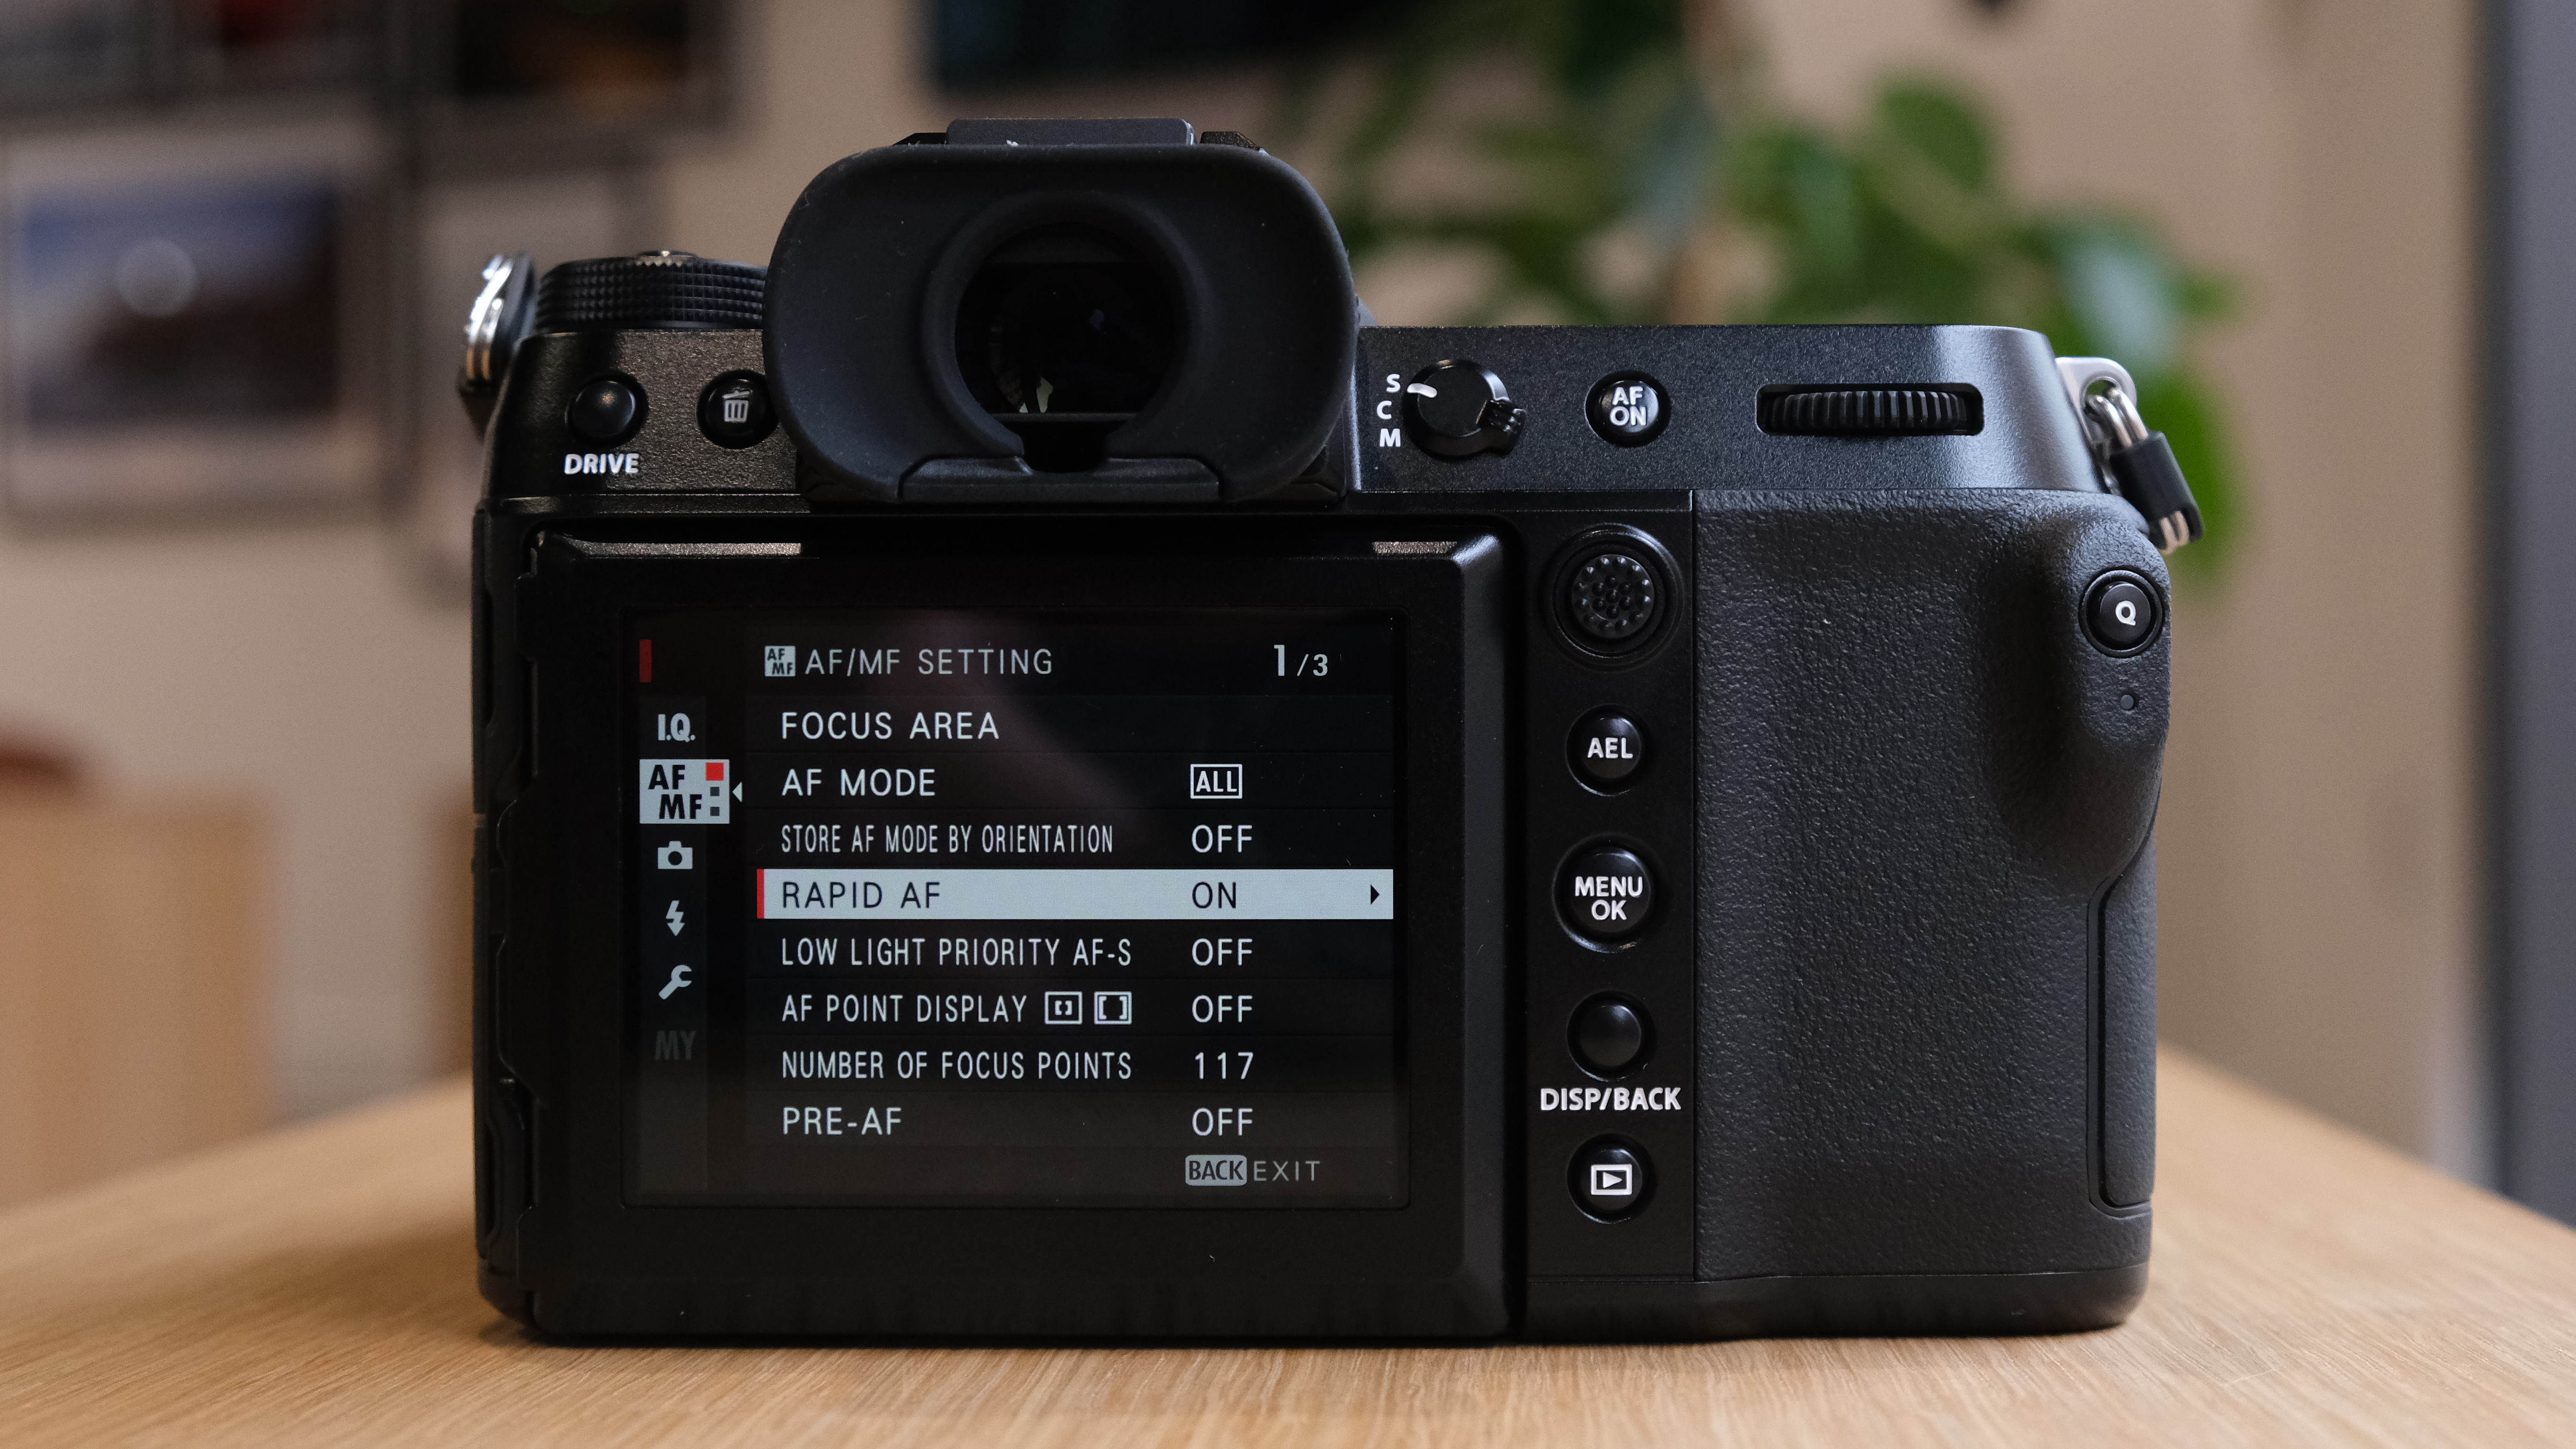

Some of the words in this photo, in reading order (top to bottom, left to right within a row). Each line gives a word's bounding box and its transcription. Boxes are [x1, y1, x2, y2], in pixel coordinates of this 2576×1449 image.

[1386, 374, 1401, 393] S
[1612, 386, 1643, 405] AF
[1376, 400, 1392, 420] C
[1609, 405, 1647, 426] ON
[1379, 428, 1401, 447] M
[564, 453, 639, 475] DRIVE
[2115, 600, 2136, 626] Q
[767, 647, 785, 661] AF
[805, 648, 900, 677] AF/MF
[918, 648, 1051, 675] SETTING
[771, 662, 793, 675] MF
[658, 713, 696, 742] I.Q.
[782, 711, 892, 740] FOCUS
[909, 712, 999, 739] AREA
[1587, 737, 1633, 759] AEL
[648, 764, 685, 790] AF
[782, 768, 822, 796] AF
[841, 768, 935, 796] MODE
[1196, 770, 1237, 792] ALL
[659, 794, 702, 820] MF
[781, 824, 841, 853] STORE
[851, 825, 874, 853] AF
[886, 824, 938, 853] MODE
[949, 825, 972, 853] BY
[982, 824, 1112, 853] ORIENTATION
[1191, 824, 1253, 853] OFF
[783, 881, 882, 908] RAPID
[900, 882, 940, 909] AF
[1192, 881, 1237, 909] ON
[1575, 876, 1643, 898] MENU
[1591, 899, 1627, 920] OK
[782, 937, 838, 965] LOW
[851, 937, 926, 966] LIGHT
[939, 938, 1060, 966] PRIORITY
[1073, 938, 1131, 966] AF-S
[1192, 938, 1253, 966] OFF
[782, 994, 812, 1022] AF
[827, 994, 903, 1022] POINT
[917, 995, 1027, 1022] DISPLAY
[1192, 995, 1253, 1023] OFF
[654, 1030, 697, 1061] MY
[782, 1051, 884, 1079] NUMBER
[897, 1051, 927, 1079] OF
[942, 1051, 1024, 1079] FOCUS
[1038, 1051, 1131, 1079] POINTS
[1195, 1052, 1254, 1080] 117
[1540, 1087, 1681, 1111] DISP/BACK
[783, 1107, 901, 1135] PRE-AF
[1192, 1108, 1253, 1136] OFF
[1189, 1160, 1243, 1180] BACK
[1253, 1161, 1320, 1181] EXIT
